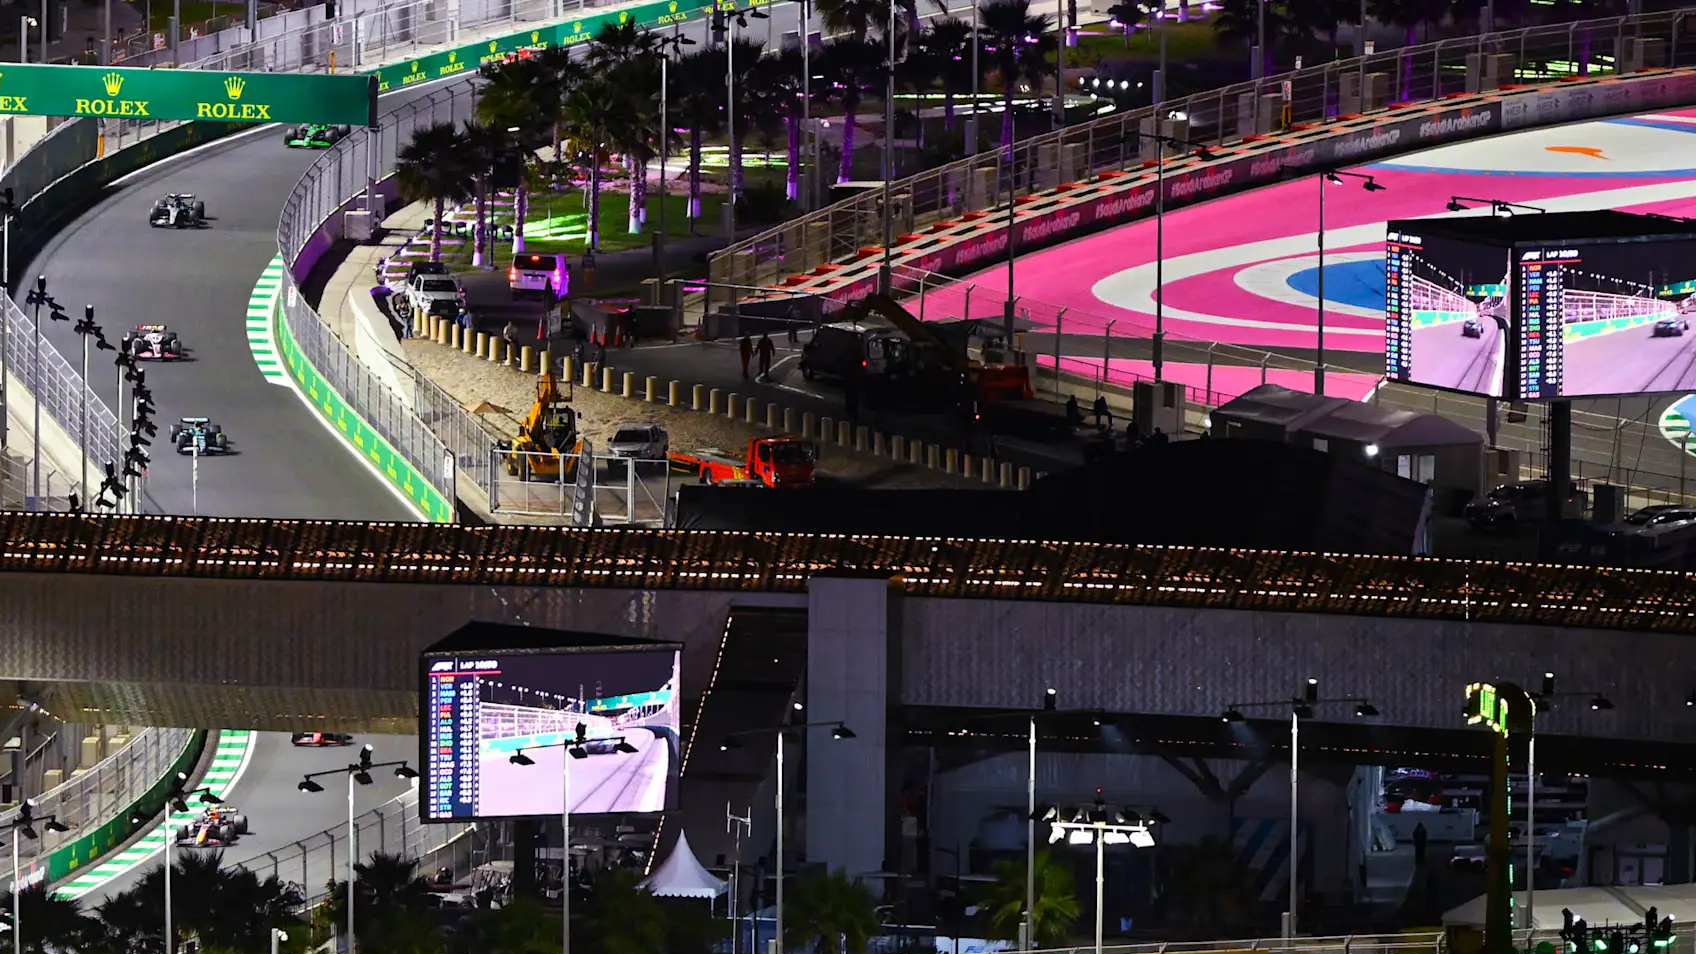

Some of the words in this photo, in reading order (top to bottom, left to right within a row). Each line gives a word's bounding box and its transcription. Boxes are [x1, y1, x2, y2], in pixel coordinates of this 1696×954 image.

[563, 32, 591, 45] ROLEX
[439, 61, 465, 75] ROLEX
[402, 71, 426, 84] ROLEX
[76, 99, 149, 116] ROLEX
[197, 102, 271, 119] ROLEX
[1419, 110, 1492, 139] #SaudiArabianGP
[440, 675, 454, 683] NOR
